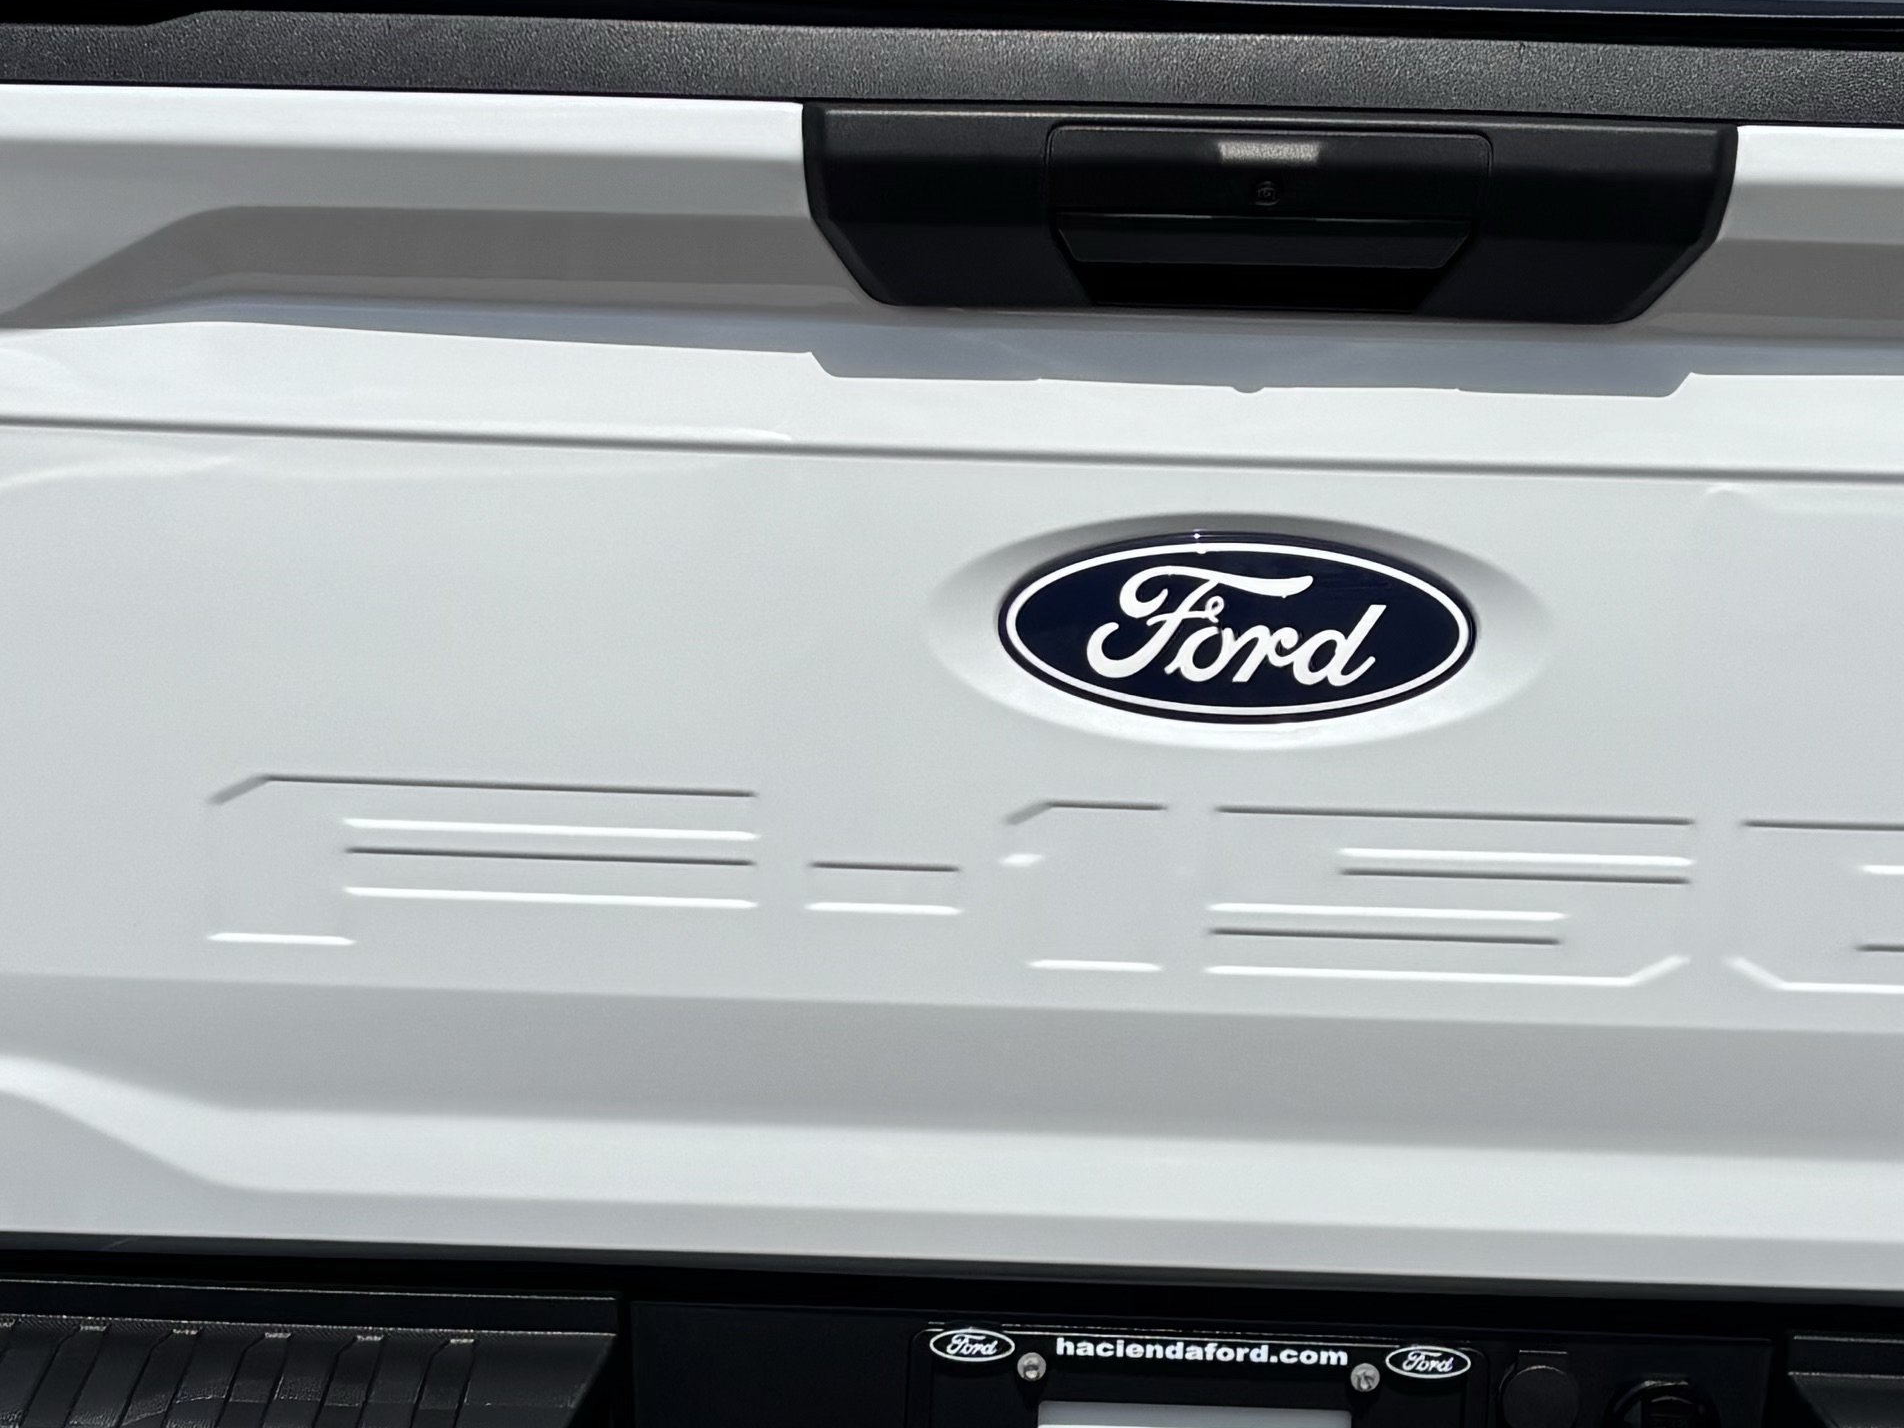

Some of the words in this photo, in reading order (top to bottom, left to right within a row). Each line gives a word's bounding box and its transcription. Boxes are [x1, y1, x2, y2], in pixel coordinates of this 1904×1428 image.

[1086, 564, 1388, 687] Ford
[945, 1334, 999, 1357] Ford
[1055, 1336, 1349, 1367] haciendaford.com
[1400, 1350, 1454, 1374] Ford
